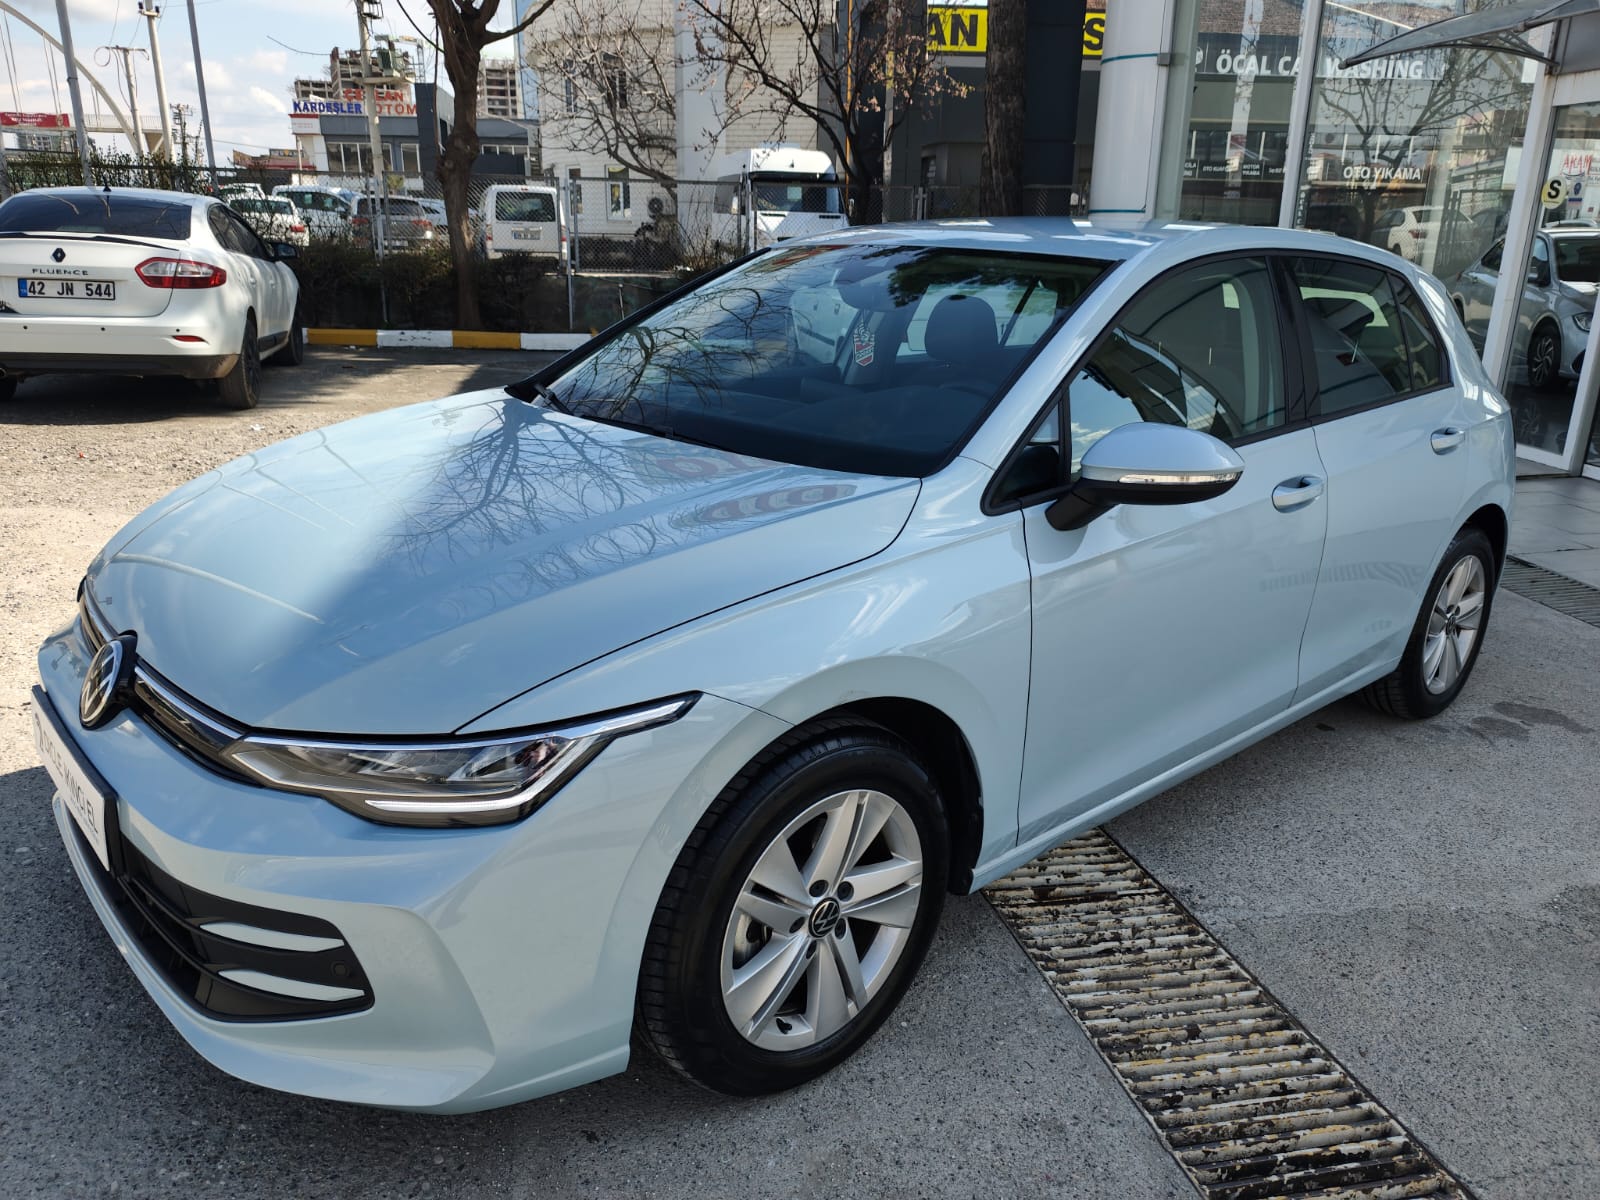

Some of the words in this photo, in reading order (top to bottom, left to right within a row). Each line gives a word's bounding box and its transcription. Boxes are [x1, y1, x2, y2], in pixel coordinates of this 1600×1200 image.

[1216, 49, 1271, 74] ÖCAL
[1278, 55, 1301, 76] CA
[342, 88, 404, 102] ÇELAN
[1343, 166, 1371, 179] OTO
[1374, 167, 1421, 180] YIKAMA
[1548, 180, 1561, 198] S
[32, 268, 89, 276] FLUENCE
[28, 281, 46, 296] 42
[57, 282, 74, 296] JN
[85, 283, 112, 298] 544
